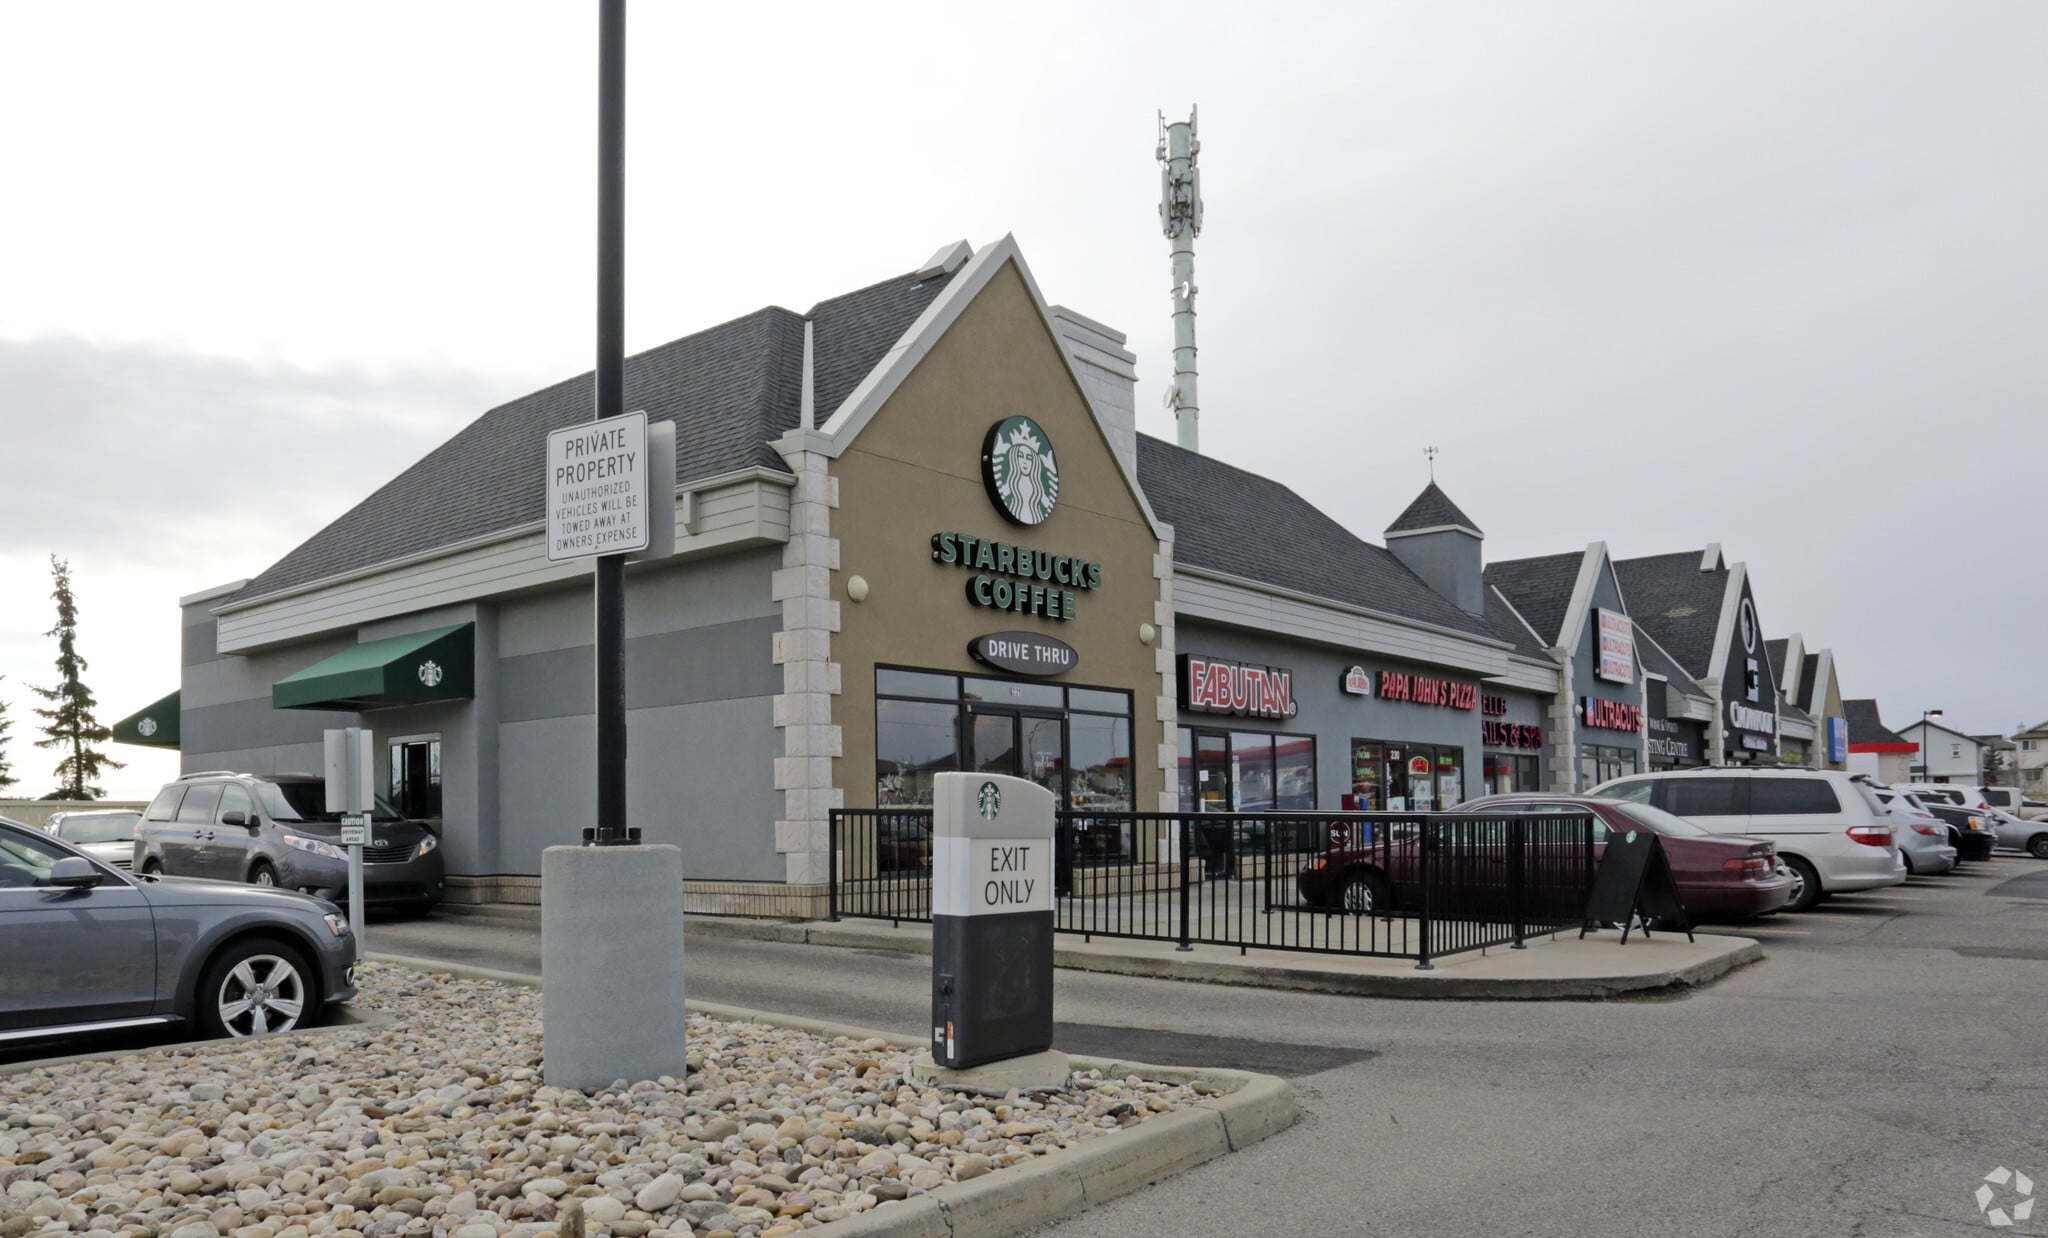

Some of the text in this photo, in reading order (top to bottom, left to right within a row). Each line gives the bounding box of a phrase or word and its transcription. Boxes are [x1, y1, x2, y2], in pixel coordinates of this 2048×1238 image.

[566, 428, 626, 460] PRIVATE
[556, 452, 636, 487] PROPERTY
[562, 481, 631, 504] UNAUTHORIZED
[556, 495, 638, 520] VEHICLES WILL BE
[562, 511, 631, 535] TOWED AWAY AT
[556, 527, 637, 551] OWNERS EXPENSE
[936, 531, 1102, 590] STARBUCKS
[973, 574, 1076, 620] COFFEE
[988, 639, 1069, 665] DRIVE THRU
[1381, 671, 1409, 700] PAPA
[1450, 681, 1478, 709] PIZZA
[1594, 698, 1641, 733] ULTRACUTS
[1510, 722, 1520, 747] &
[1523, 725, 1543, 749] SPA
[1666, 737, 1688, 757] CENTRE
[991, 846, 1030, 872] EXIT
[984, 878, 1034, 906] ONLY
